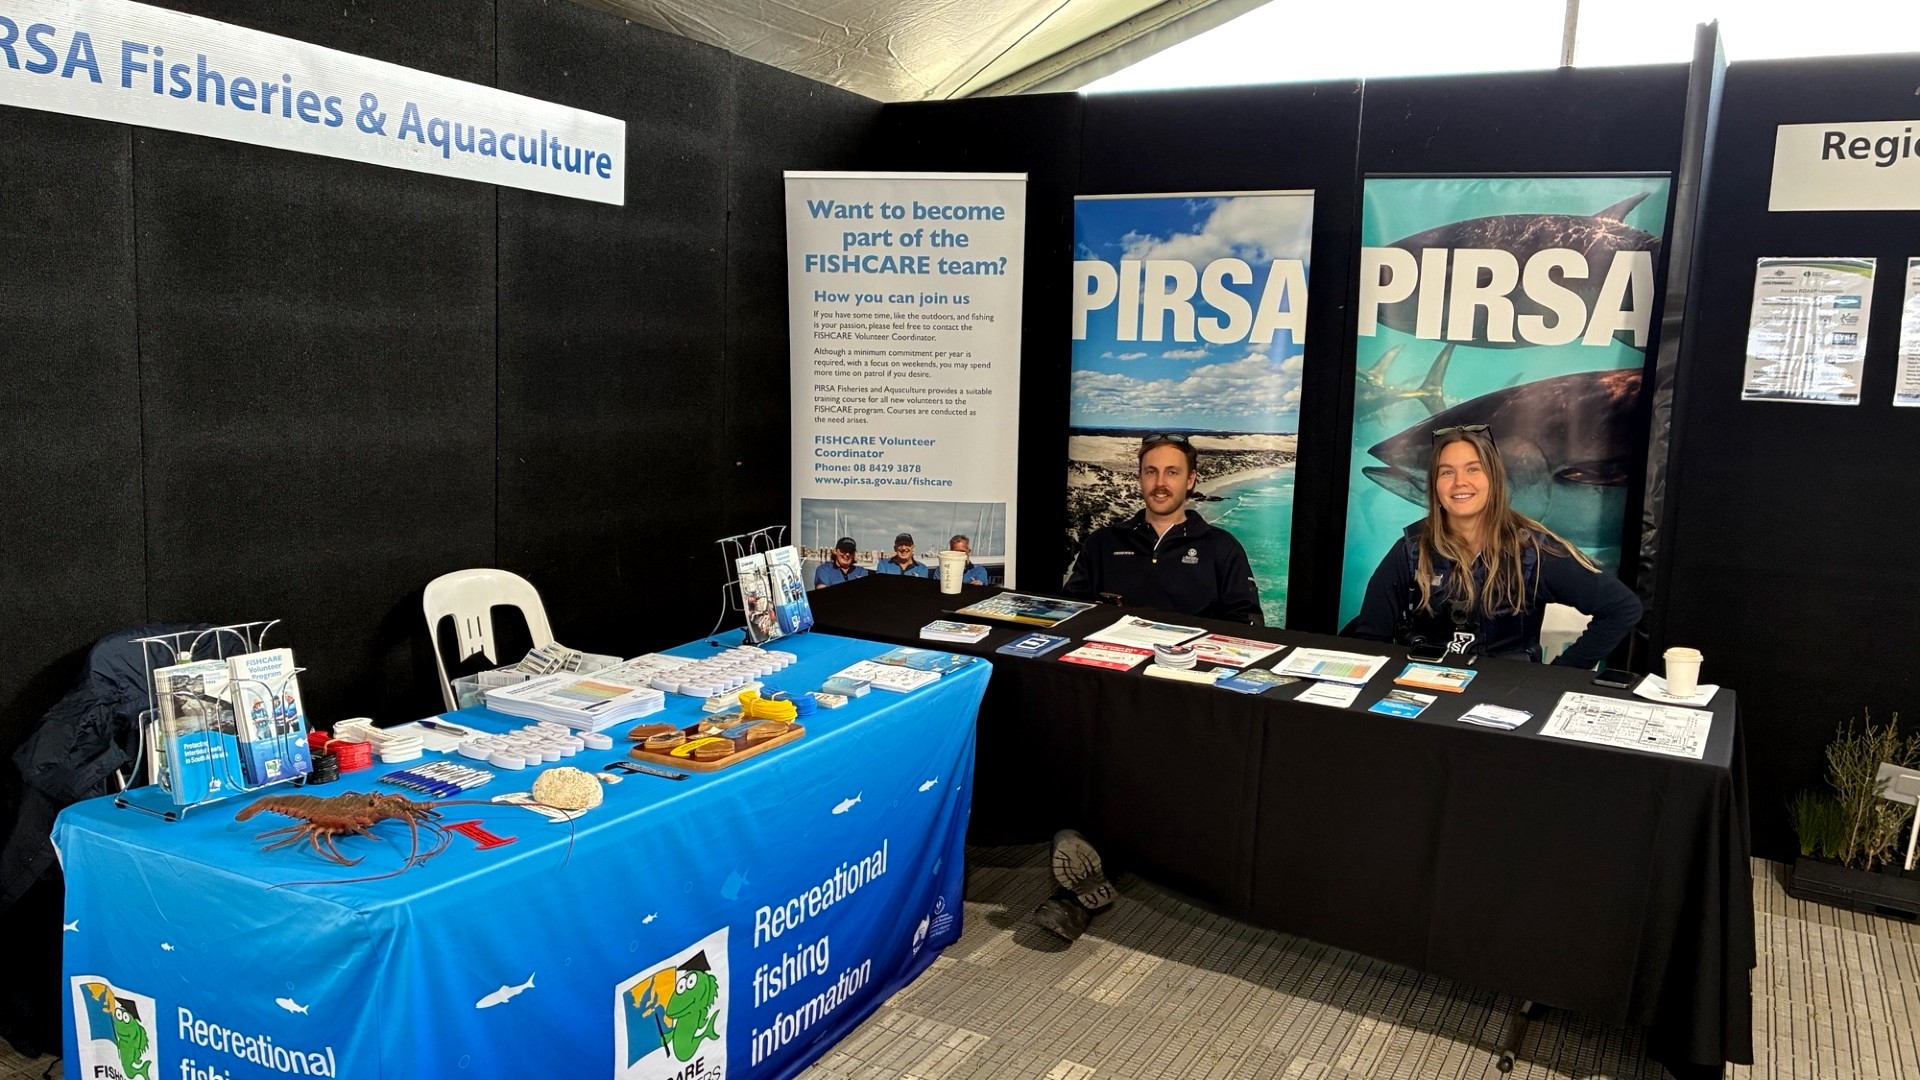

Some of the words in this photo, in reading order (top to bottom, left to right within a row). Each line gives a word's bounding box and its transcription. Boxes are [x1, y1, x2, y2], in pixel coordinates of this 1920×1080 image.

[120, 41, 343, 127] Fisheries
[355, 92, 386, 137] &
[397, 101, 612, 179] Aquaculture
[1822, 127, 1920, 168] Regi
[807, 200, 873, 218] Want
[881, 202, 905, 219] to
[913, 202, 1005, 220] become
[843, 229, 892, 250] part
[899, 229, 923, 247] of
[930, 229, 969, 247] the
[805, 254, 930, 274] FISHCARE
[938, 256, 1007, 275] team?
[814, 291, 850, 302] How
[855, 292, 882, 306] you
[888, 294, 914, 304] can
[919, 292, 947, 307] join
[953, 295, 970, 304] us
[1072, 257, 1308, 345] PIRSA
[1357, 248, 1654, 347] PIRSA
[820, 312, 833, 321] you
[835, 311, 851, 319] have
[875, 312, 892, 320] time,
[907, 312, 919, 320] the
[922, 312, 955, 321] outdoors,
[972, 313, 994, 322] fishing
[840, 322, 867, 331] passion,
[869, 322, 890, 331] please
[893, 322, 905, 330] feel
[907, 322, 921, 330] free
[814, 332, 852, 340] FISHCARE
[855, 332, 889, 340] Volunteer
[892, 333, 936, 341] Coordinator.
[814, 348, 846, 357] Although
[949, 351, 963, 359] year
[814, 359, 845, 368] required,
[902, 360, 938, 368] weekends,
[954, 362, 968, 370] may
[970, 361, 991, 370] spend
[864, 370, 885, 379] patrol
[908, 370, 931, 378] desire.
[837, 385, 868, 393] Fisheries
[870, 385, 882, 393] and
[884, 386, 926, 395] Aquaculture
[928, 387, 957, 396] provides
[966, 387, 992, 395] suitable
[814, 395, 840, 404] training
[907, 397, 943, 405] volunteers
[814, 405, 852, 413] FISHCARE
[854, 407, 885, 416] program.
[887, 407, 916, 415] Courses
[931, 408, 967, 416] conducted
[815, 436, 875, 445] FISHCARE
[879, 436, 935, 446] Volunteer
[815, 448, 884, 458] Coordinator
[815, 463, 851, 471] Phone:
[869, 464, 893, 472] 8429
[897, 464, 921, 473] 3878
[815, 476, 952, 487] www.pir.sa.gov.au/fishcare
[246, 655, 282, 666] FISHCARE
[249, 663, 282, 674] Volunteer
[252, 671, 281, 680] Program
[754, 839, 887, 949] Recreational
[753, 936, 829, 1008] fishing
[751, 958, 871, 1067] information
[178, 1006, 336, 1077] Recreational
[667, 1056, 704, 1080] ARE
